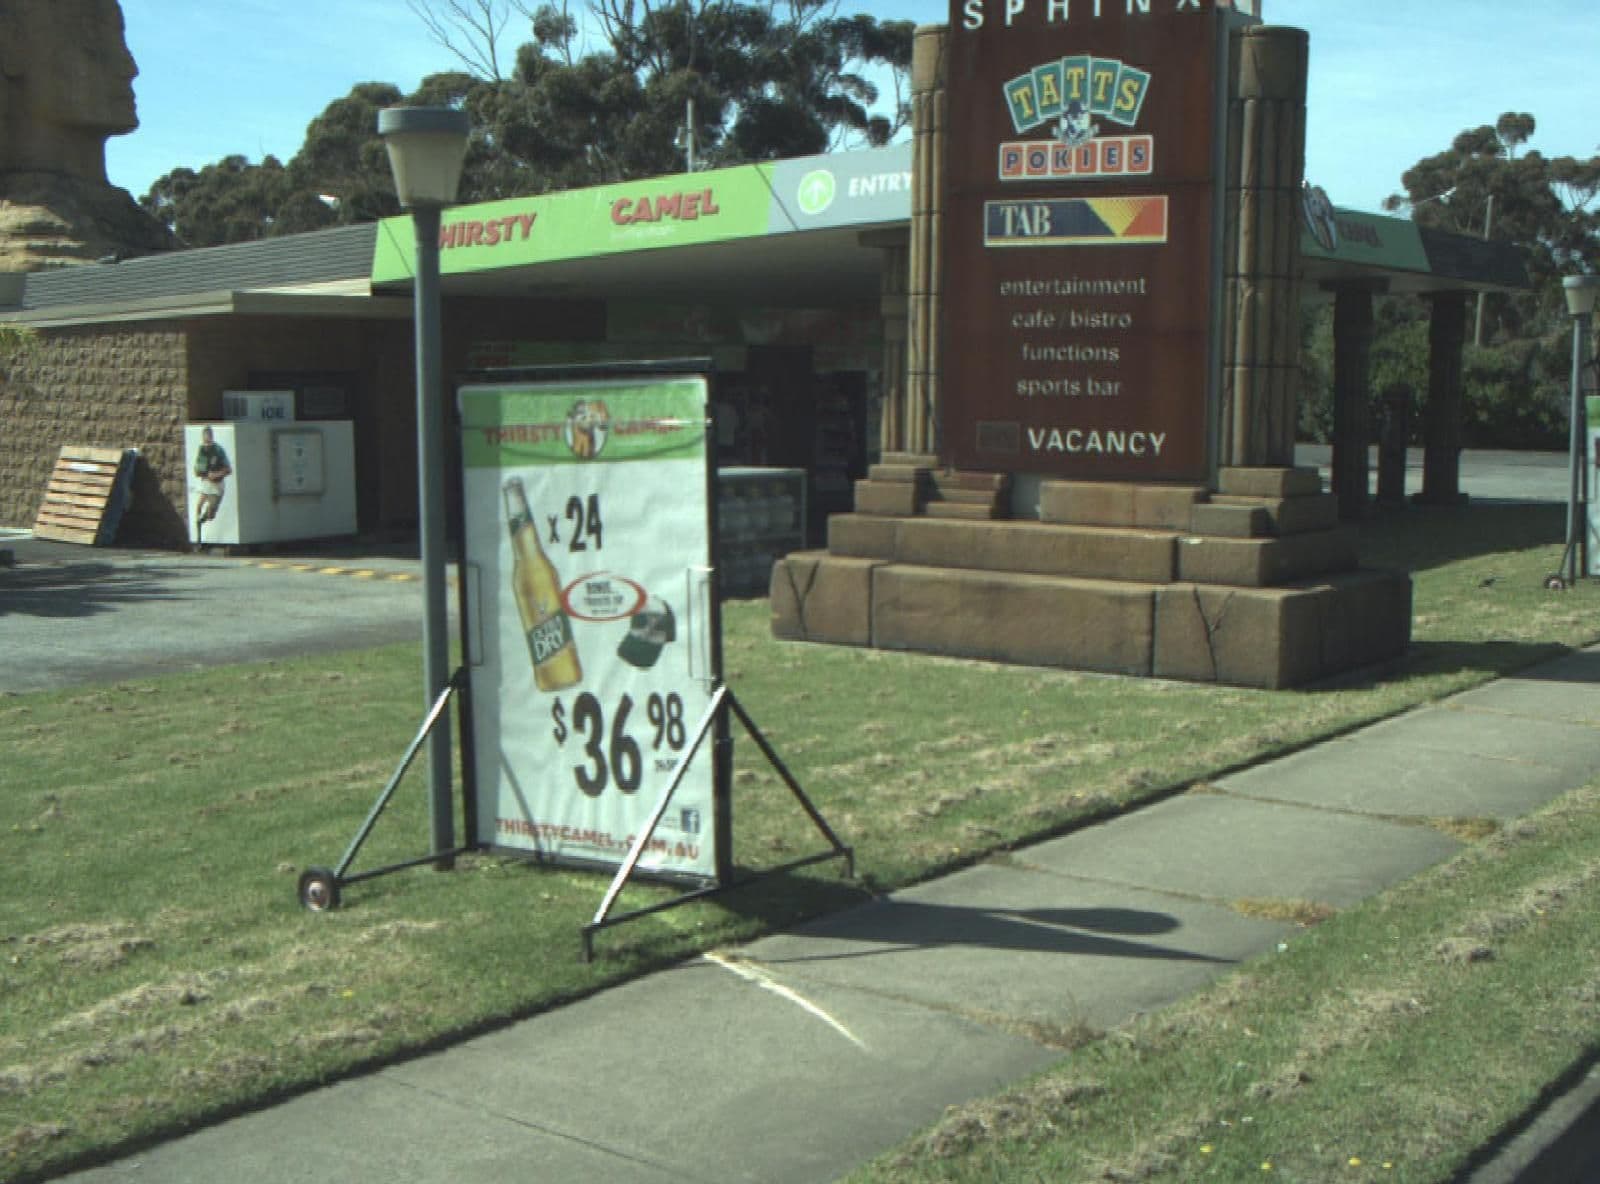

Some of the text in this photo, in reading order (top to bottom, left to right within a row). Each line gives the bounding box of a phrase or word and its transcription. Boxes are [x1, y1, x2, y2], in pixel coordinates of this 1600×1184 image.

[1011, 66, 1140, 120] TATTS
[1006, 146, 1145, 169] POKIES
[439, 188, 719, 248] HIRSTY CAMEL
[999, 205, 1051, 237] TAB
[1000, 276, 1147, 297] entertainment
[1022, 342, 1121, 362] functions
[1016, 376, 1121, 398] sports bar
[484, 424, 562, 445] THIRSTY
[1027, 428, 1167, 455] VACANCY
[566, 493, 602, 553] 24
[496, 818, 699, 860] THIRSTYCAMEL.CM.AU
